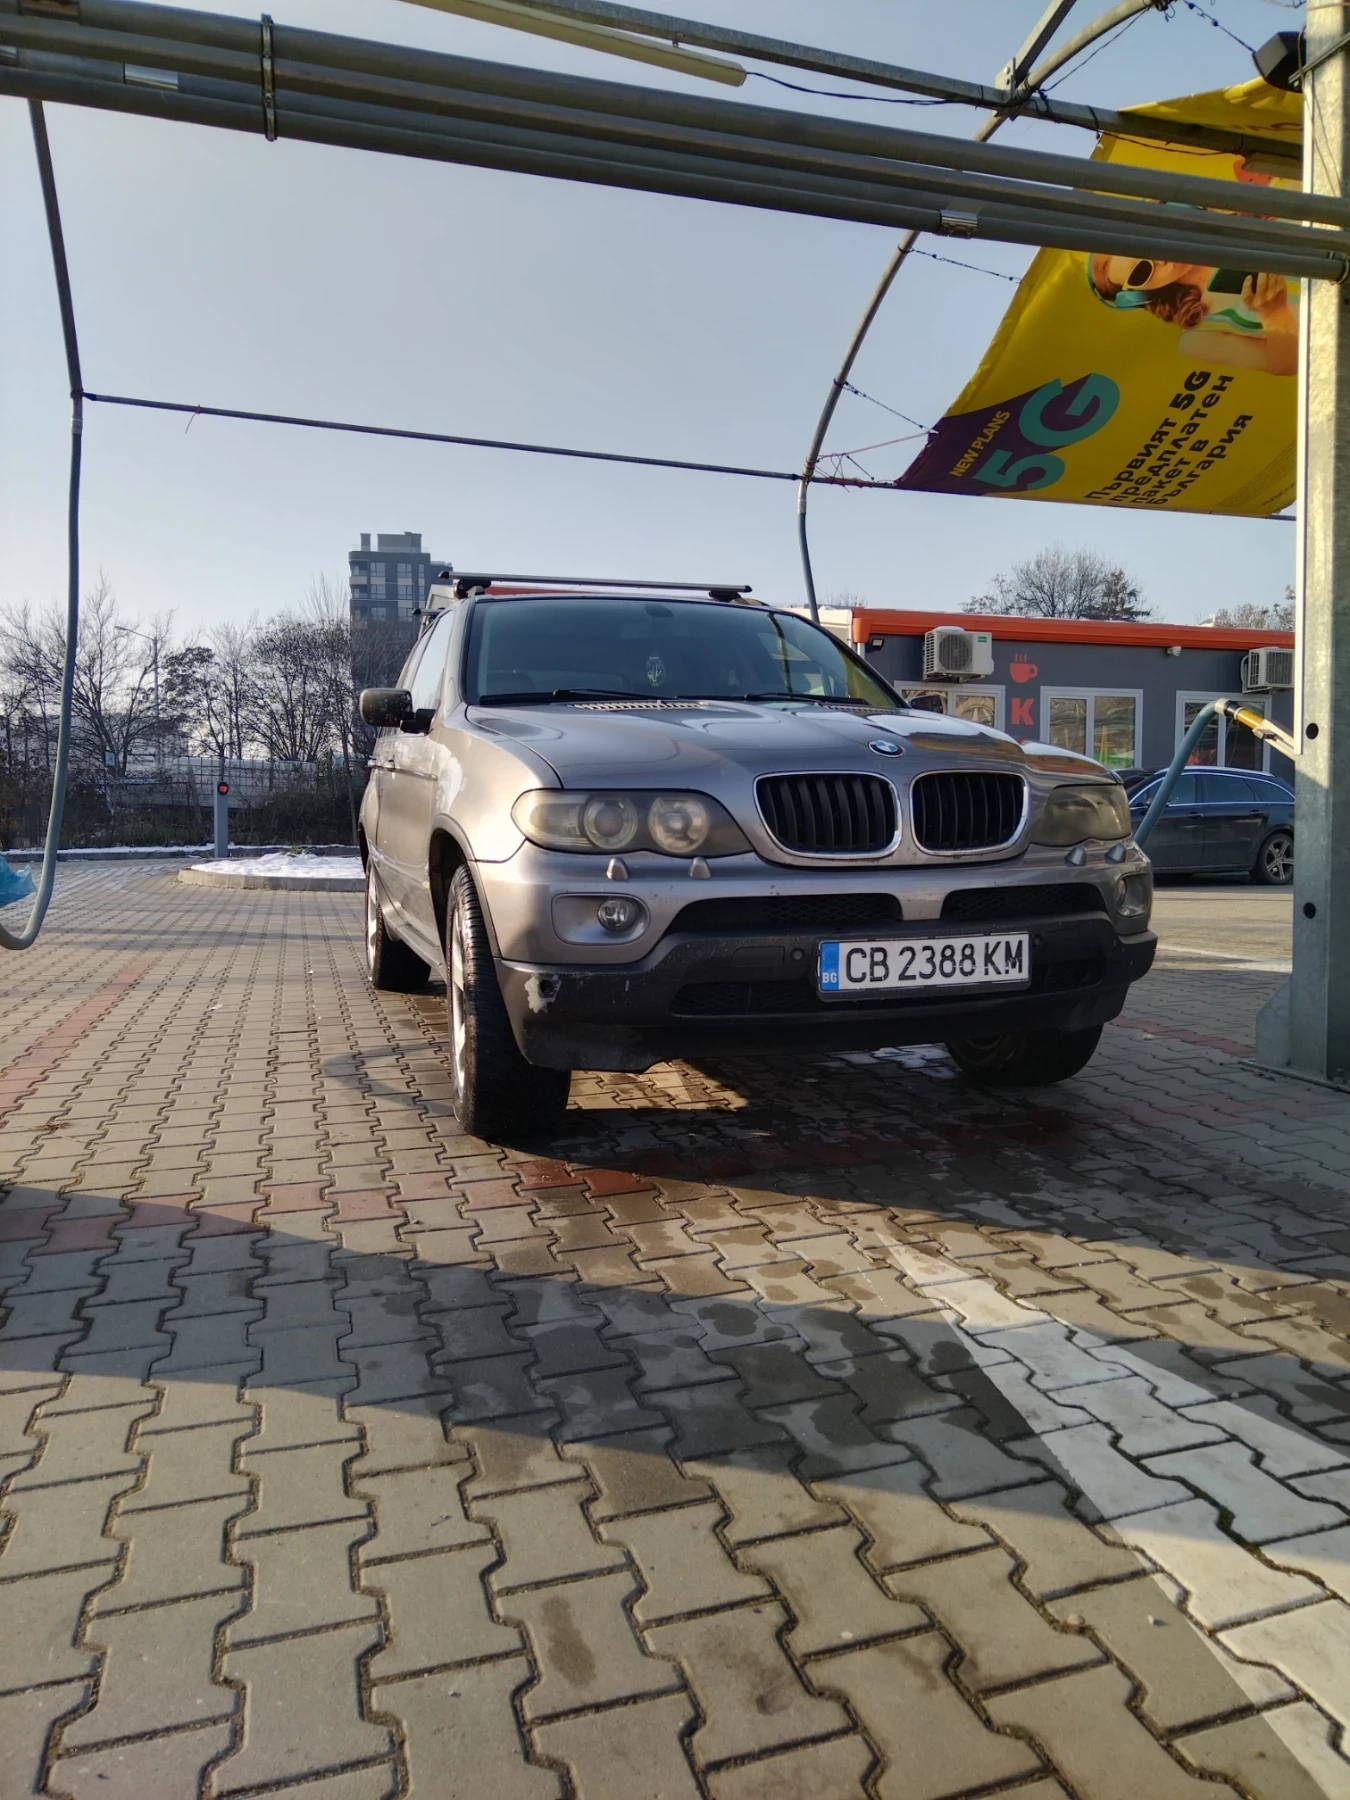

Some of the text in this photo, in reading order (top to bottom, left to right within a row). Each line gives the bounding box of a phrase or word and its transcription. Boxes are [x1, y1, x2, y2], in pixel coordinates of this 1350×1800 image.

[950, 410, 1011, 477] NEW PLANS
[972, 372, 1121, 491] 5G
[1083, 371, 1212, 499] Първият 5G
[1108, 375, 1234, 502] предплатен
[1145, 414, 1254, 504] България
[1130, 458, 1191, 503] пакет
[822, 973, 838, 983] BG
[898, 943, 977, 981] 2388
